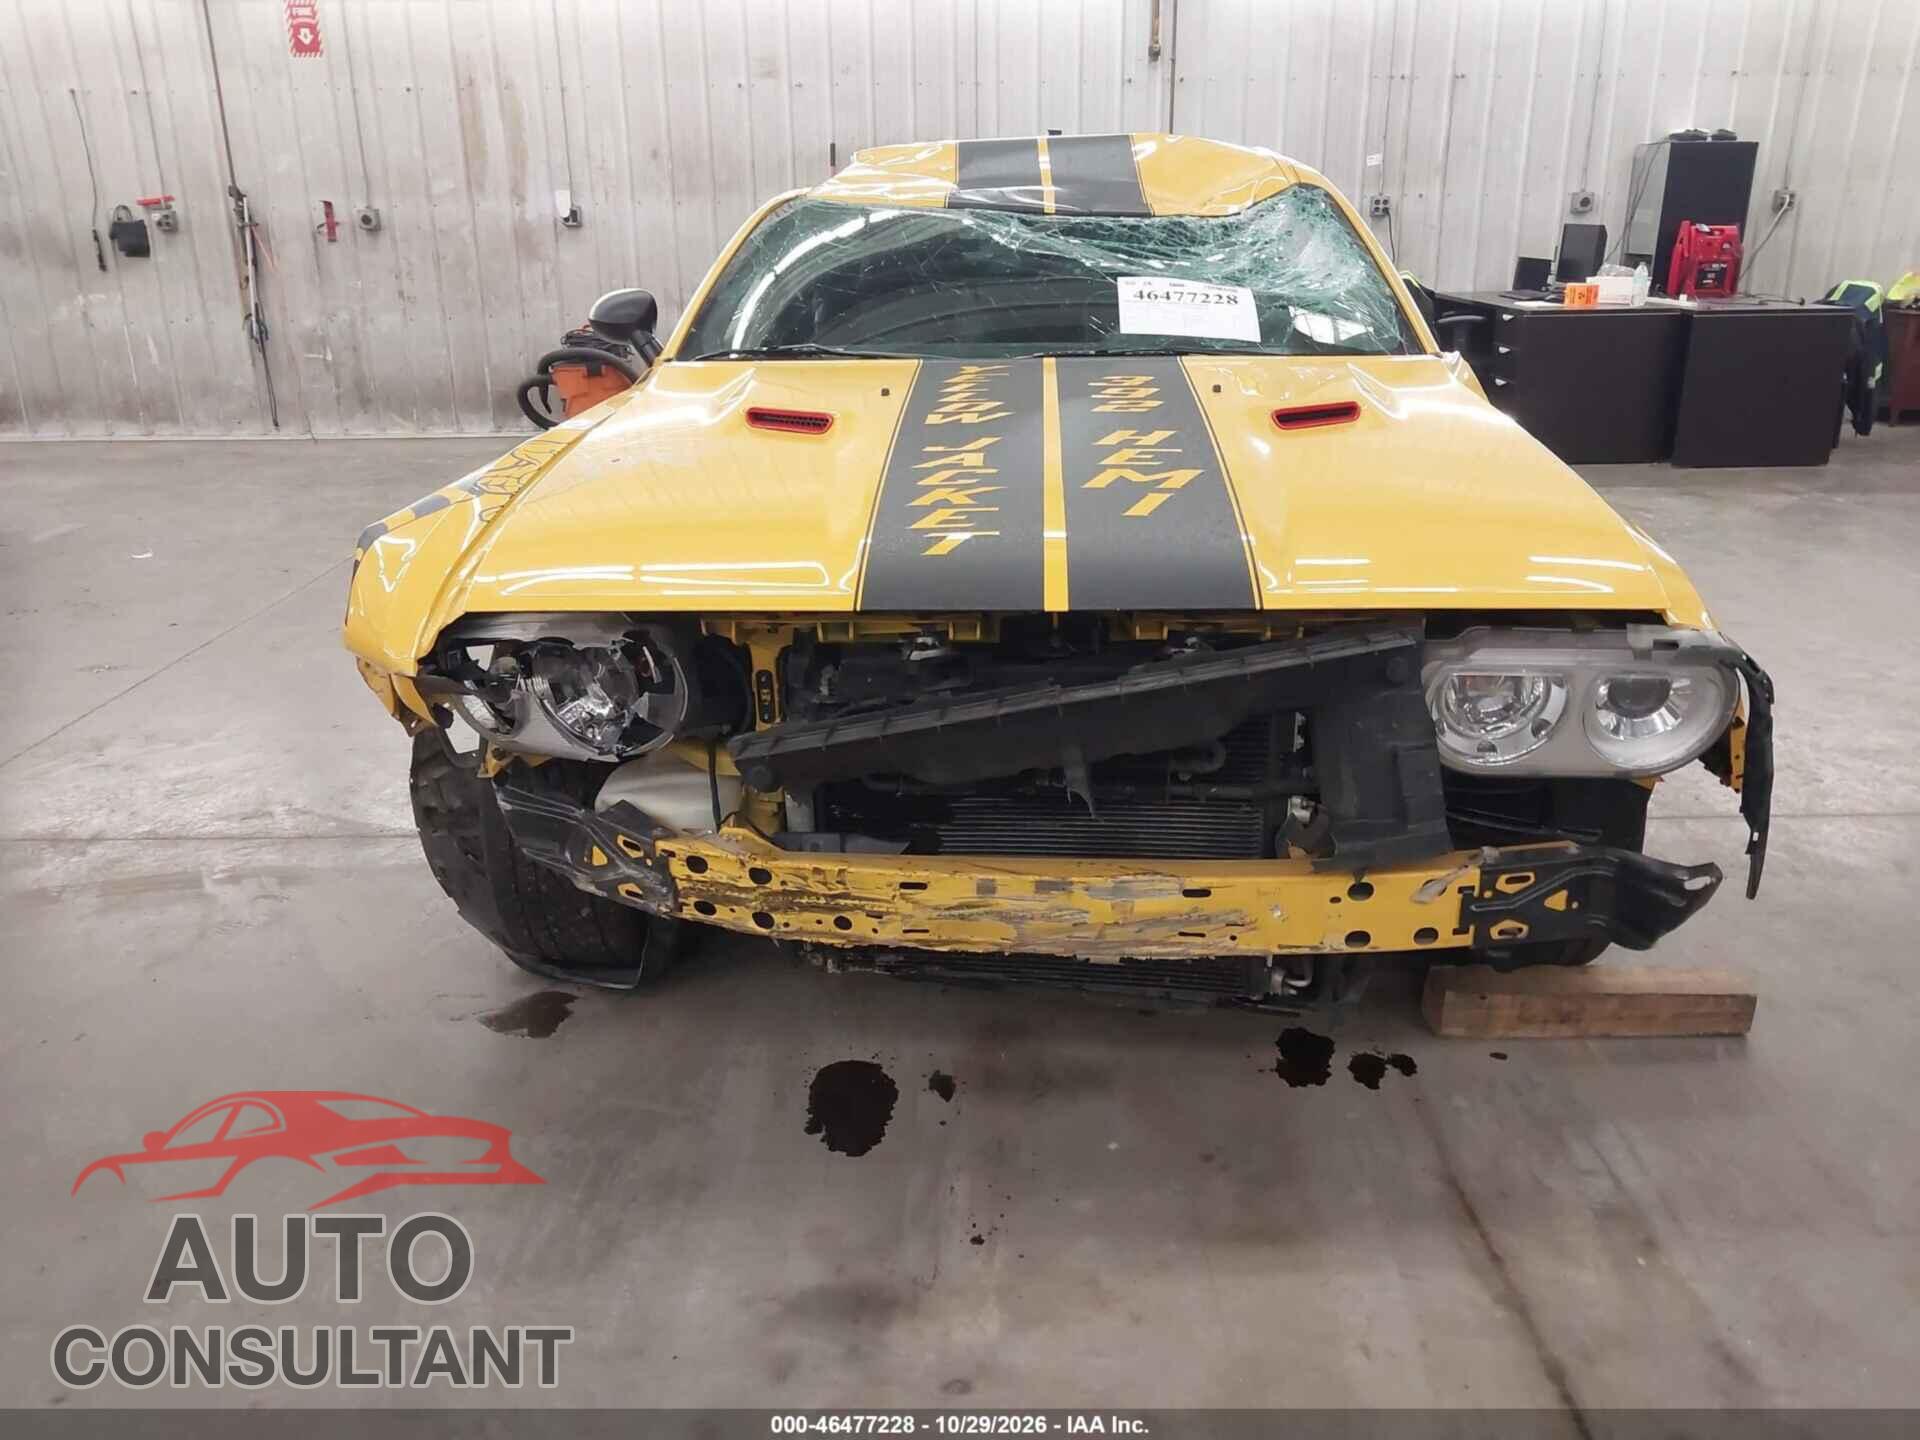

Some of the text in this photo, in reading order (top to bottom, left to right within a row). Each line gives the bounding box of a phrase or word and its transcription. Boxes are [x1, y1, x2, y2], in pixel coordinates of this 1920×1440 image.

[1133, 289, 1239, 305] 46477228
[904, 436, 1009, 556] JACKET
[1080, 375, 1206, 517] 392 HEMI
